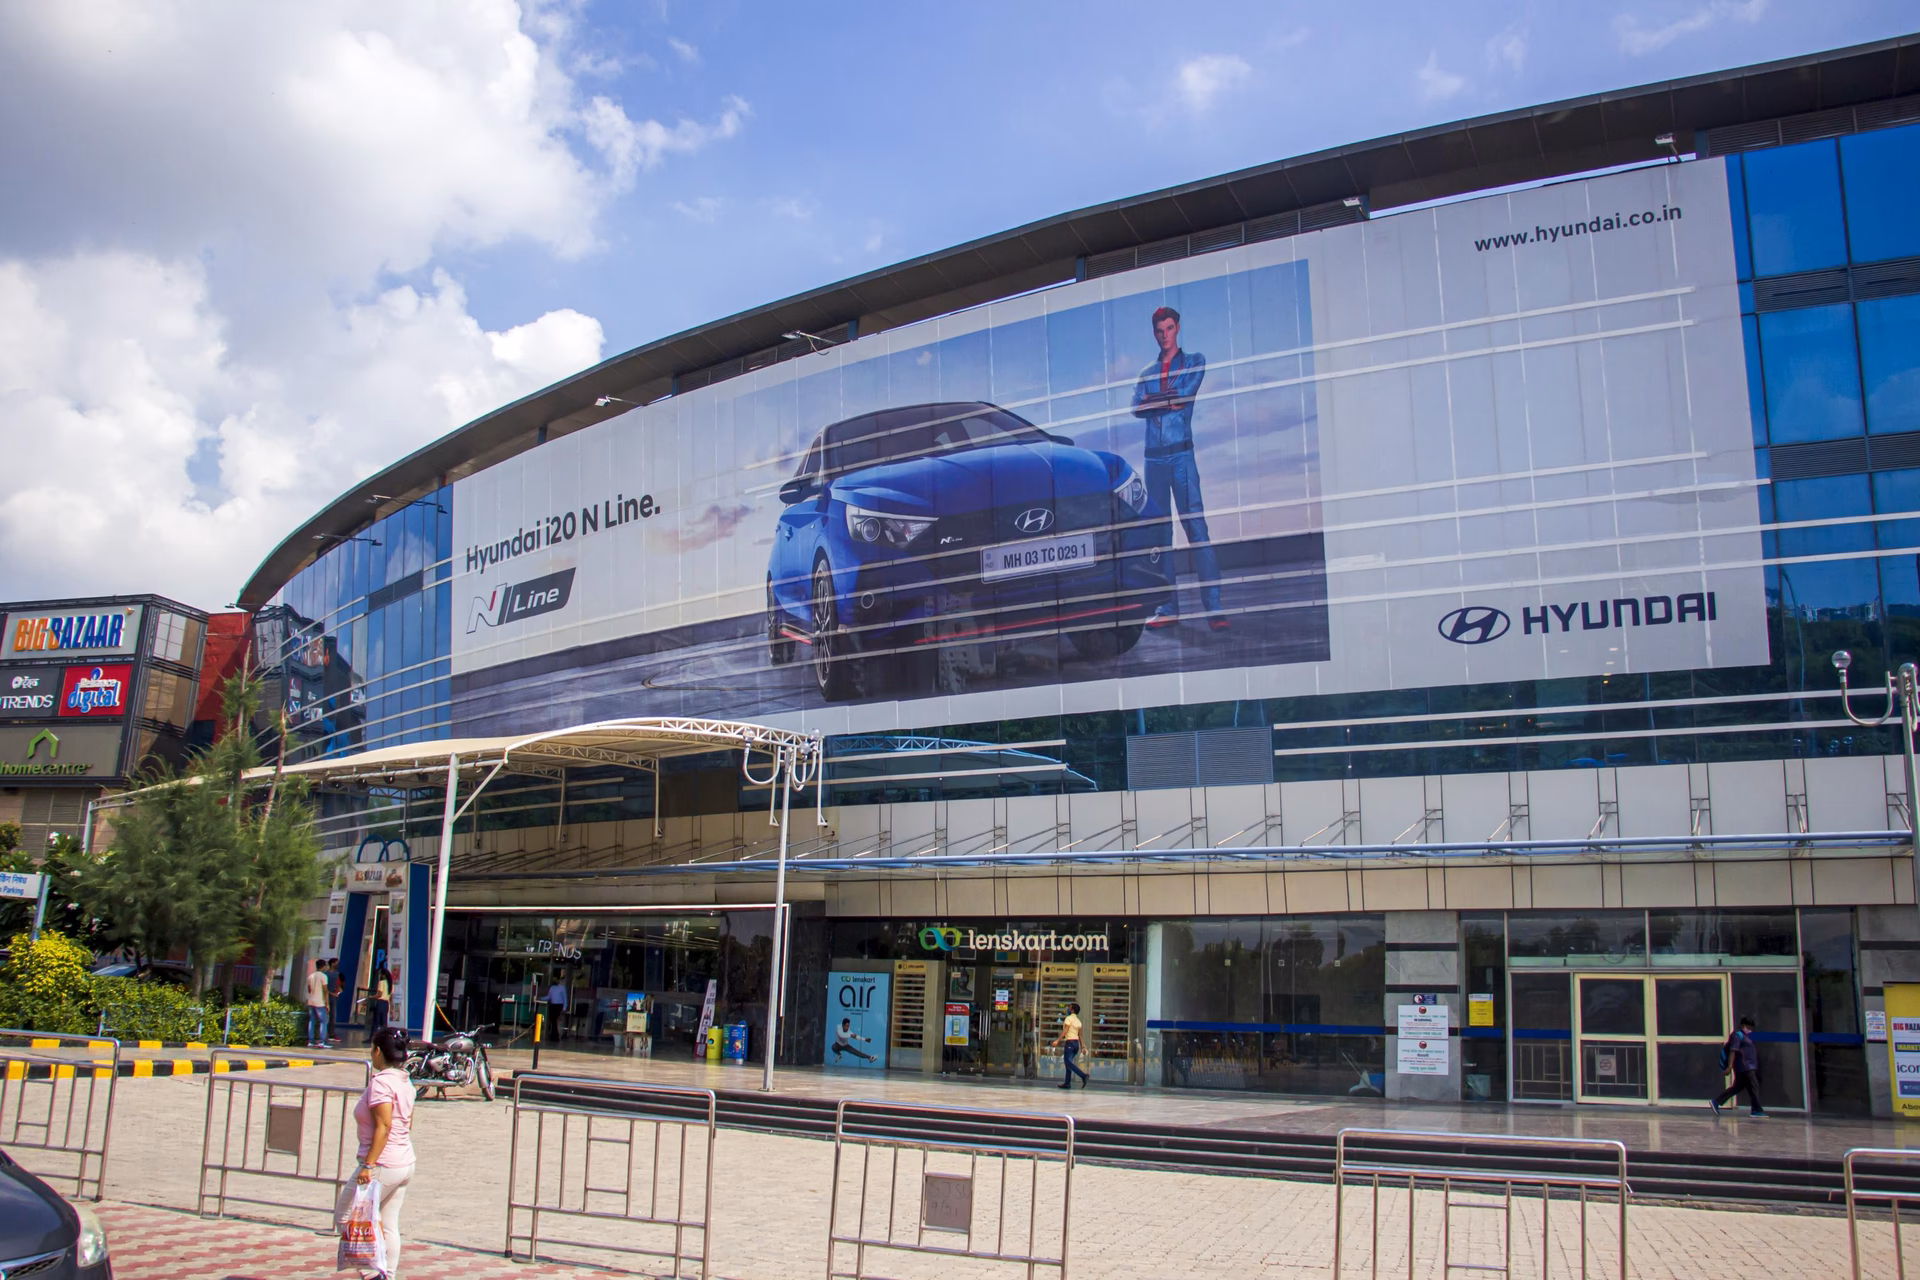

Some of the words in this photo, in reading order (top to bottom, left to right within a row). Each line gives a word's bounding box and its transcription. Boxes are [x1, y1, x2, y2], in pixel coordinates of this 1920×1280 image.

[1474, 204, 1682, 252] www.hyundai.co.in
[466, 520, 541, 574] Hyundai
[545, 511, 577, 546] i20
[581, 504, 599, 535] N
[604, 493, 661, 529] Line.
[1003, 553, 1022, 569] MH
[1025, 551, 1039, 565] 03
[1041, 547, 1056, 563] TC
[1057, 545, 1078, 560] 029
[1080, 543, 1087, 557] 1
[512, 586, 560, 613] Line
[1522, 591, 1717, 635] HYUNDAI
[13, 617, 50, 652] BIG
[48, 614, 125, 650] BAZAAR
[1, 694, 54, 709] TRENDS
[67, 681, 121, 713] digital
[3, 885, 24, 896] Parking
[968, 929, 1109, 951] lenskart.com
[839, 985, 876, 1009] air
